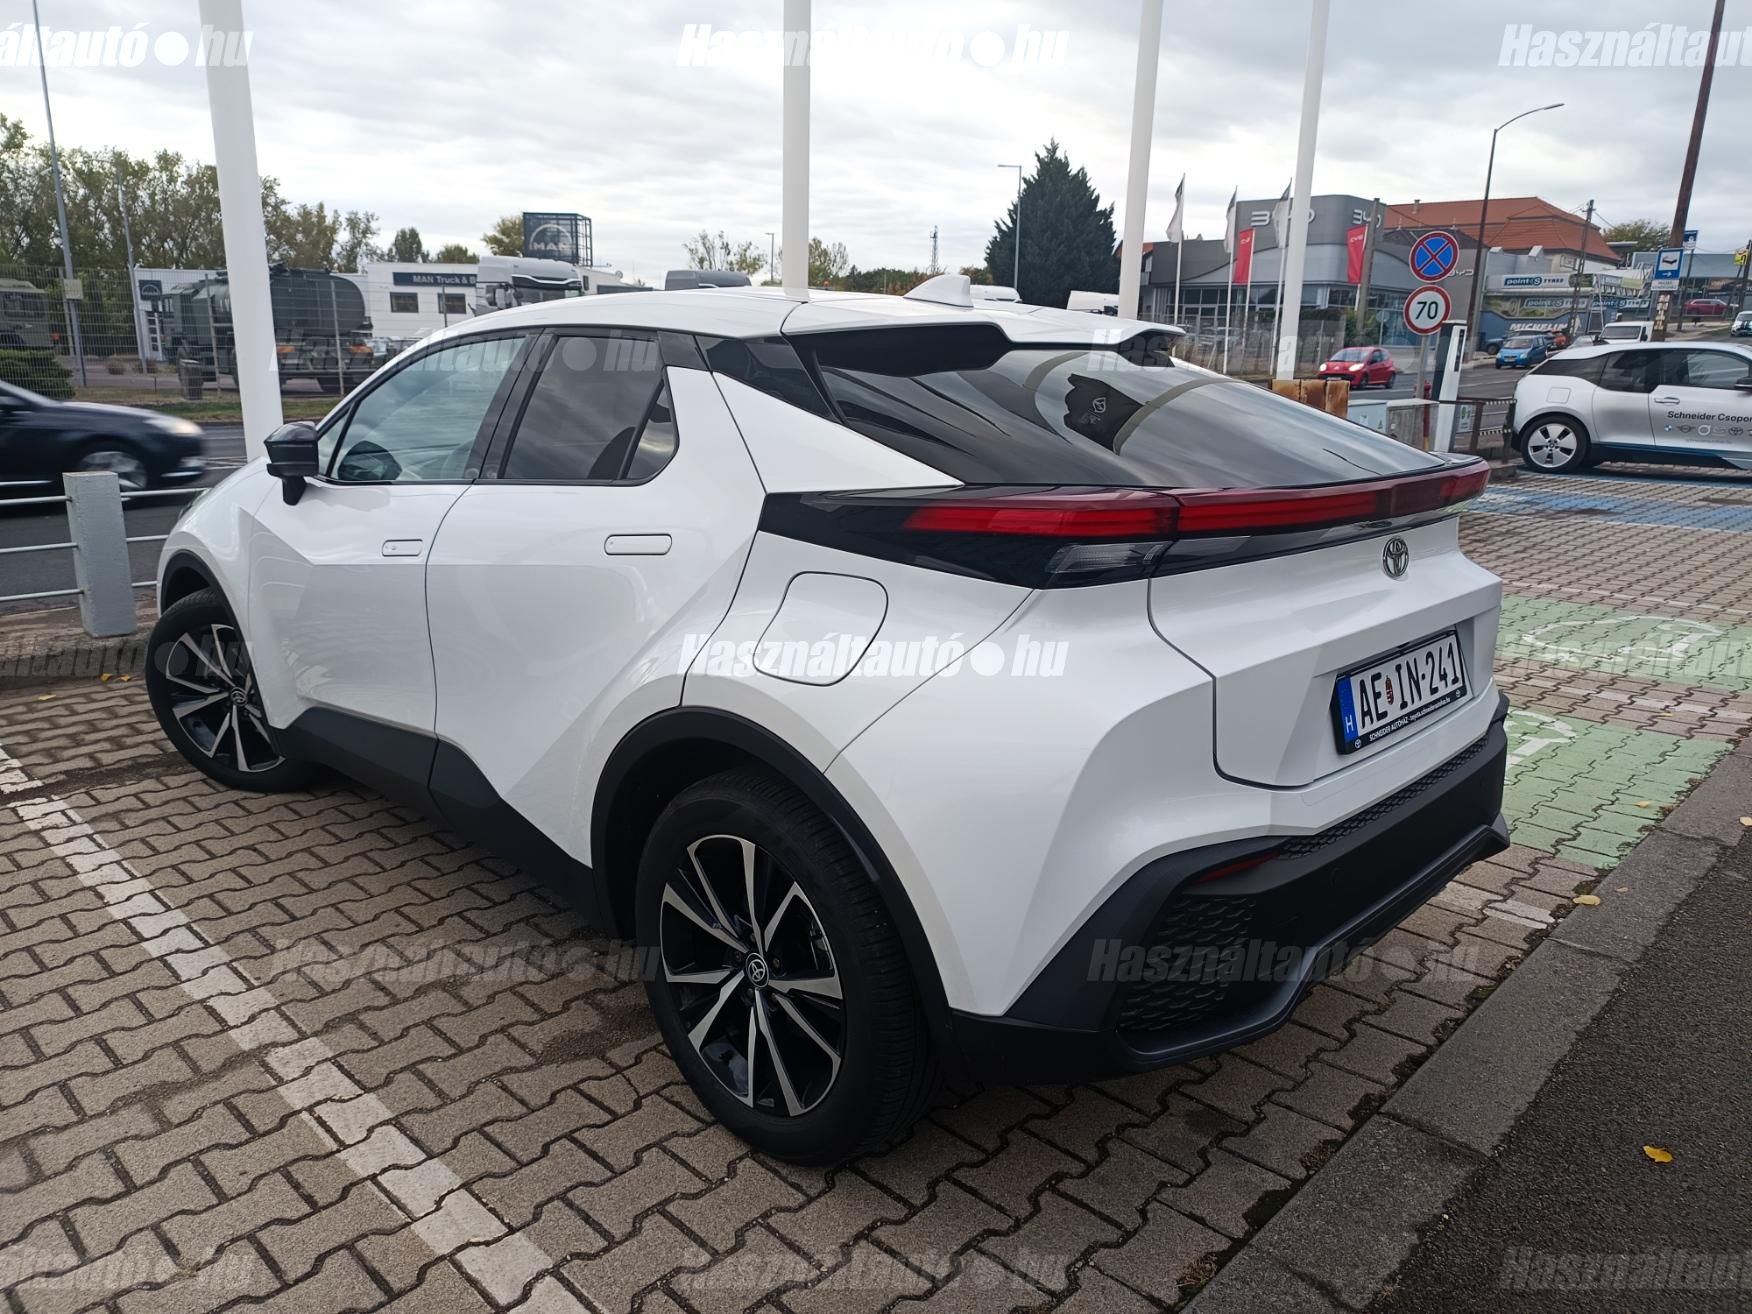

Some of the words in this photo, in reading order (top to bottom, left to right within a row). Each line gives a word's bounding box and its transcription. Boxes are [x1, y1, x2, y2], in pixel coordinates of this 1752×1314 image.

[413, 275, 434, 284] MAN
[436, 275, 461, 284] Truck
[1506, 277, 1531, 286] point
[1415, 300, 1439, 320] 70
[1509, 322, 1569, 332] MICHELIN
[1667, 410, 1716, 420] Schneider
[1345, 714, 1354, 734] H
